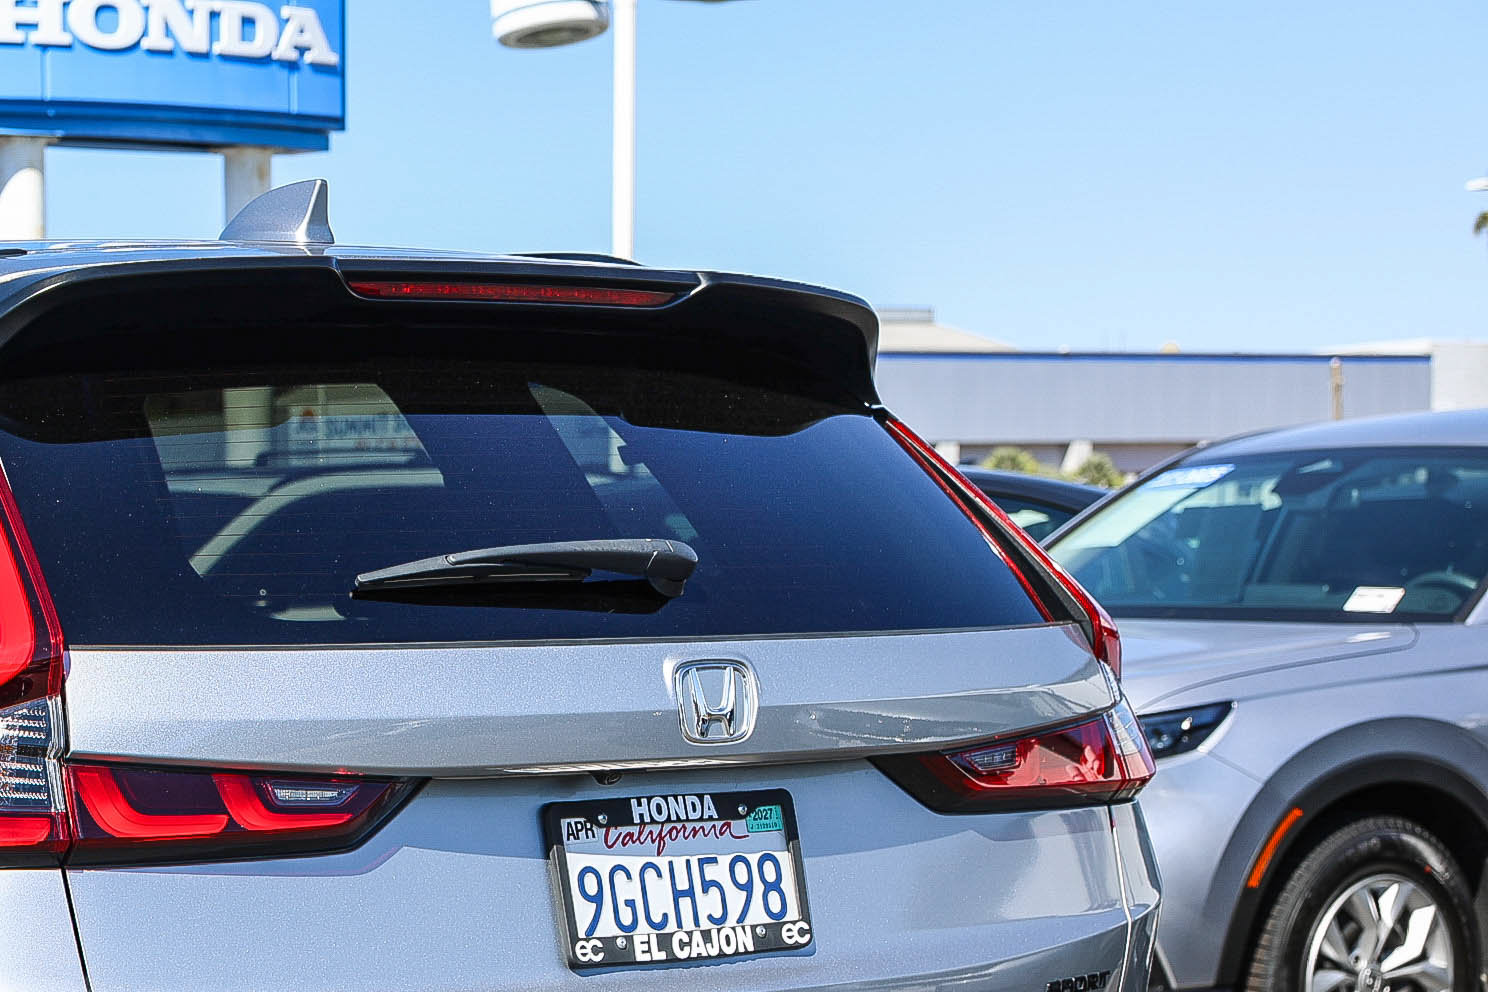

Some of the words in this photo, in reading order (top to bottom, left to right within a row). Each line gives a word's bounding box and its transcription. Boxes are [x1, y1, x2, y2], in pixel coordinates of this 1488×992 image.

[631, 794, 718, 823] HONDA
[566, 821, 596, 842] APR
[604, 820, 750, 856] California
[577, 852, 788, 938] 9GCH598
[633, 933, 667, 962] EL
[672, 925, 755, 959] CAJON
